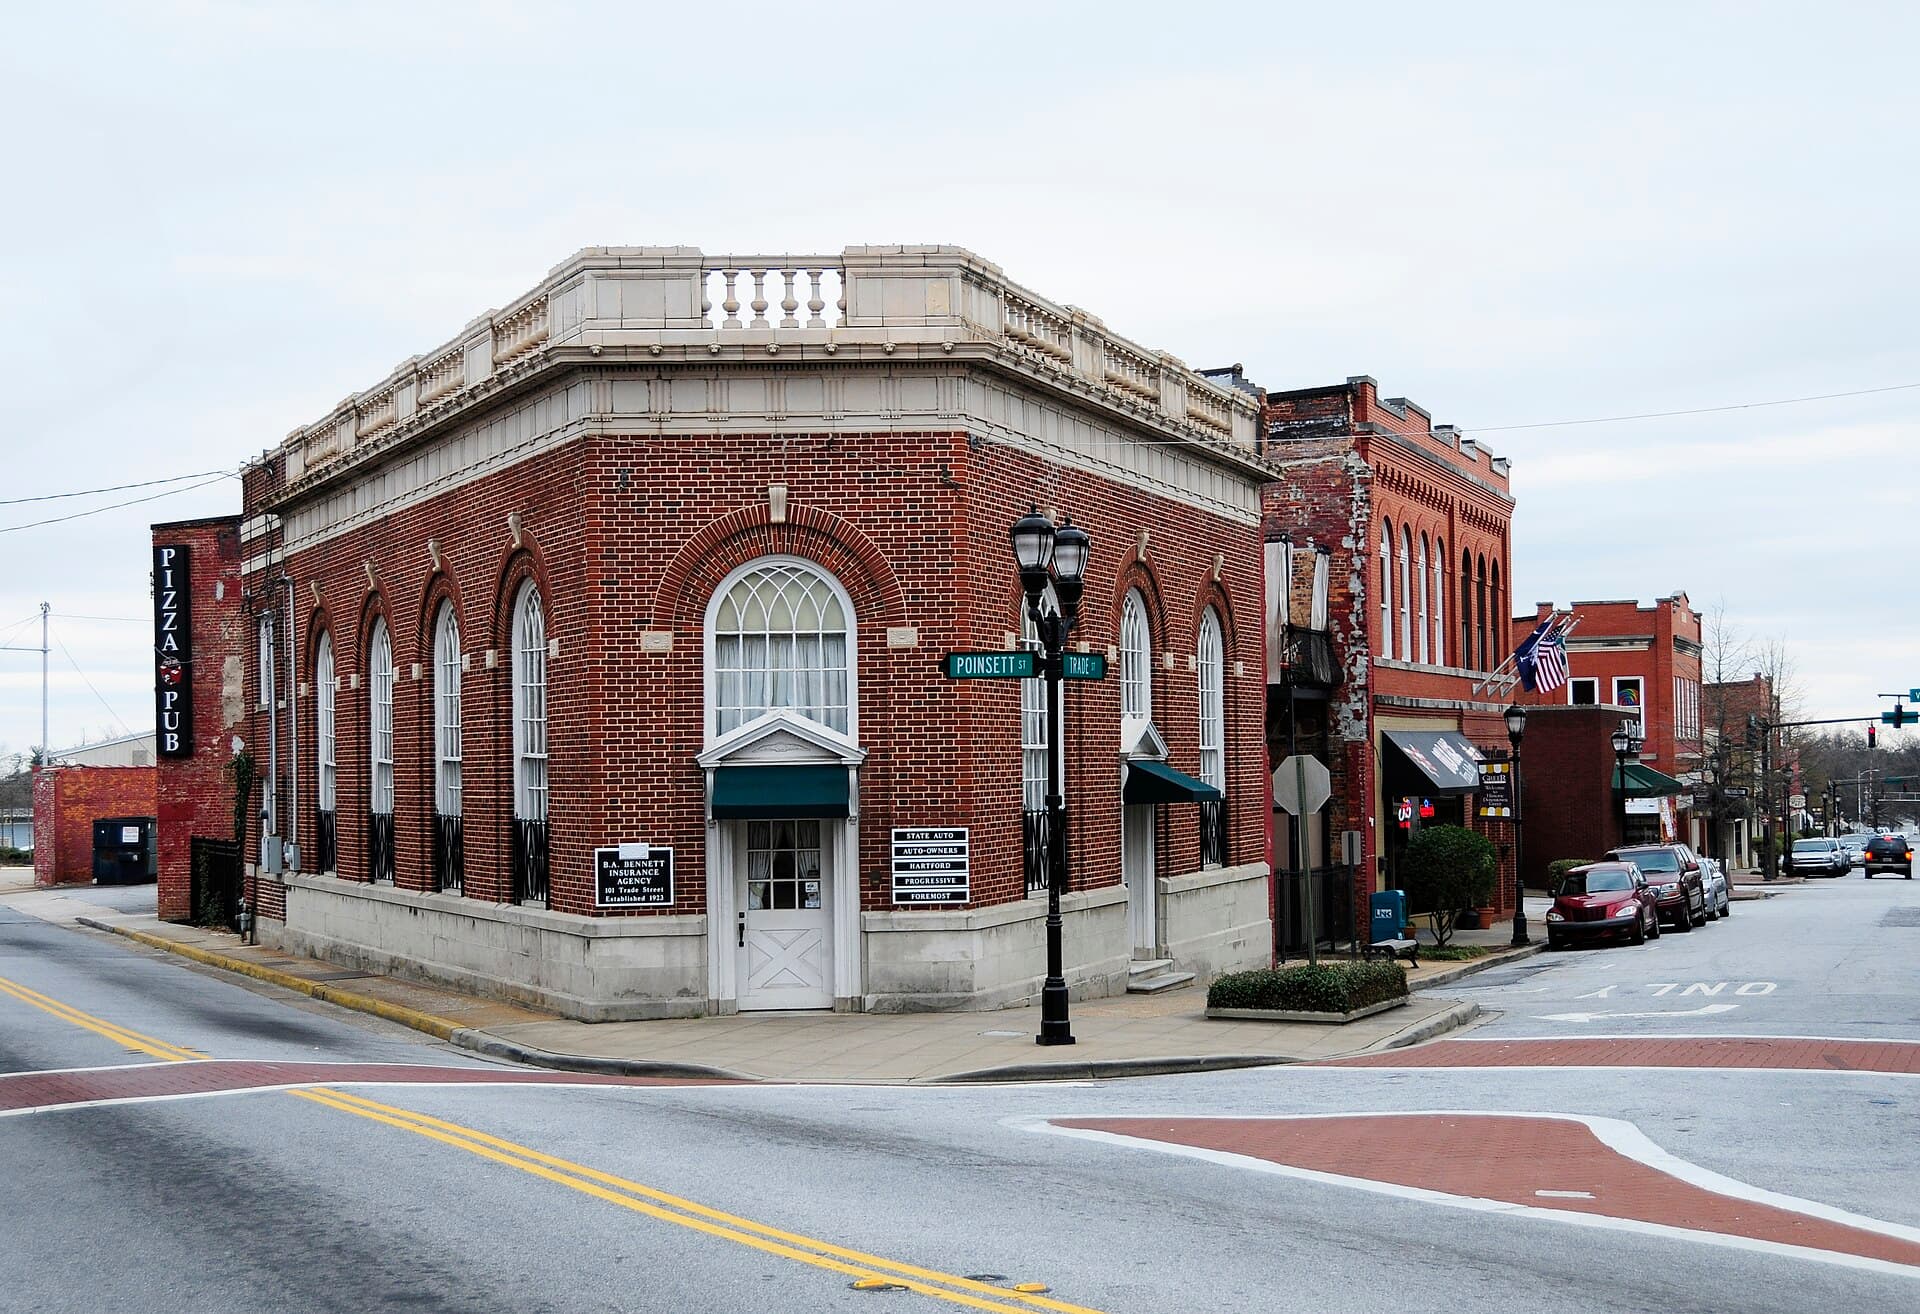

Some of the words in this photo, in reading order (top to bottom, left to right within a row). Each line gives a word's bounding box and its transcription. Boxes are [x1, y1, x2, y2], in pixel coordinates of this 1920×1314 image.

[161, 548, 179, 651] PIZZA
[956, 656, 1015, 675] POINSETT
[1018, 659, 1026, 670] ST
[1069, 656, 1090, 675] TRADE
[164, 691, 180, 752] PUB
[906, 832, 930, 840] STATE
[903, 847, 958, 855] AUTO-OWNERS
[603, 861, 620, 869] B.A.
[624, 860, 665, 868] BENNETT
[909, 862, 951, 870] HARTFORD
[609, 868, 660, 877] INSURANCE
[617, 877, 652, 885] AGENCY
[905, 877, 956, 885] PROGRESSIVE
[911, 892, 952, 900] FOREMOST
[1574, 981, 1778, 1000] ONLY
